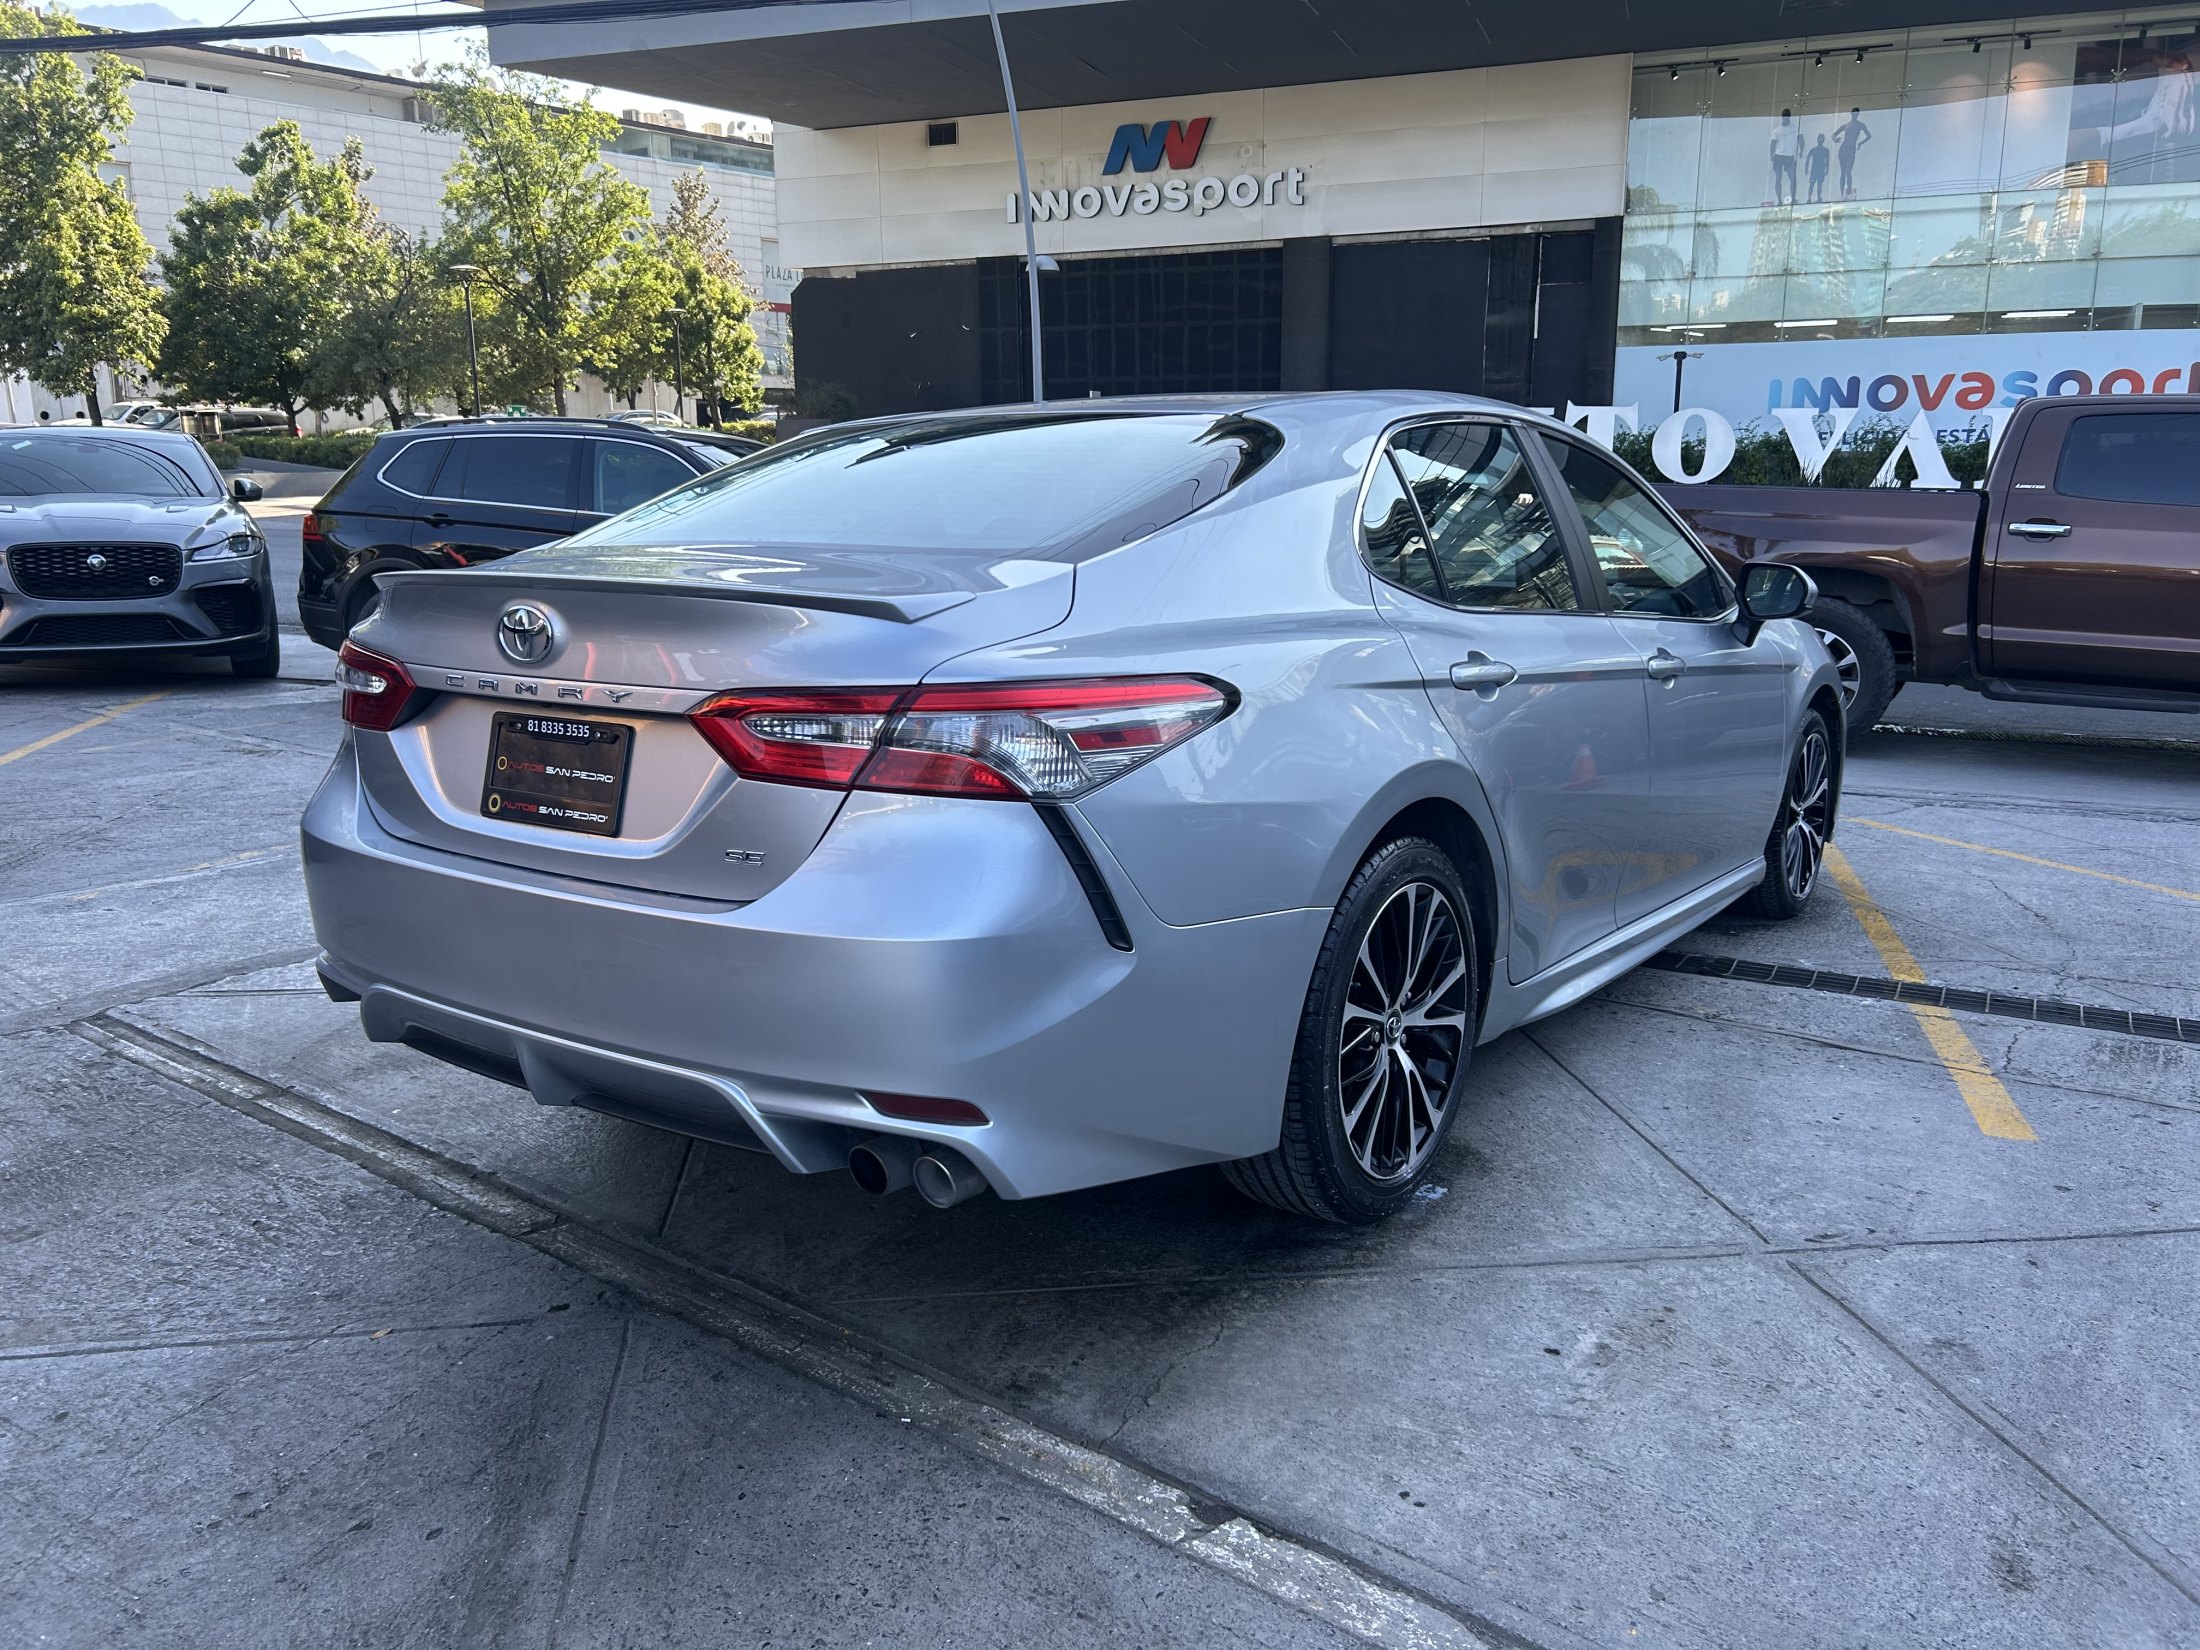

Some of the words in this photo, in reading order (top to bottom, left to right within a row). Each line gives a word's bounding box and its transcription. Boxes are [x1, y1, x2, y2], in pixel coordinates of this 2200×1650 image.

[765, 264, 793, 281] PLAZA
[445, 674, 633, 703] CAMRY
[527, 719, 539, 732] 81
[541, 720, 564, 735] 8335
[566, 723, 590, 738] 3535
[508, 761, 545, 773] AUTOS
[545, 766, 571, 777] SAN
[501, 801, 538, 812] AUTOS
[538, 806, 564, 816] SAN
[725, 849, 765, 867] SE
